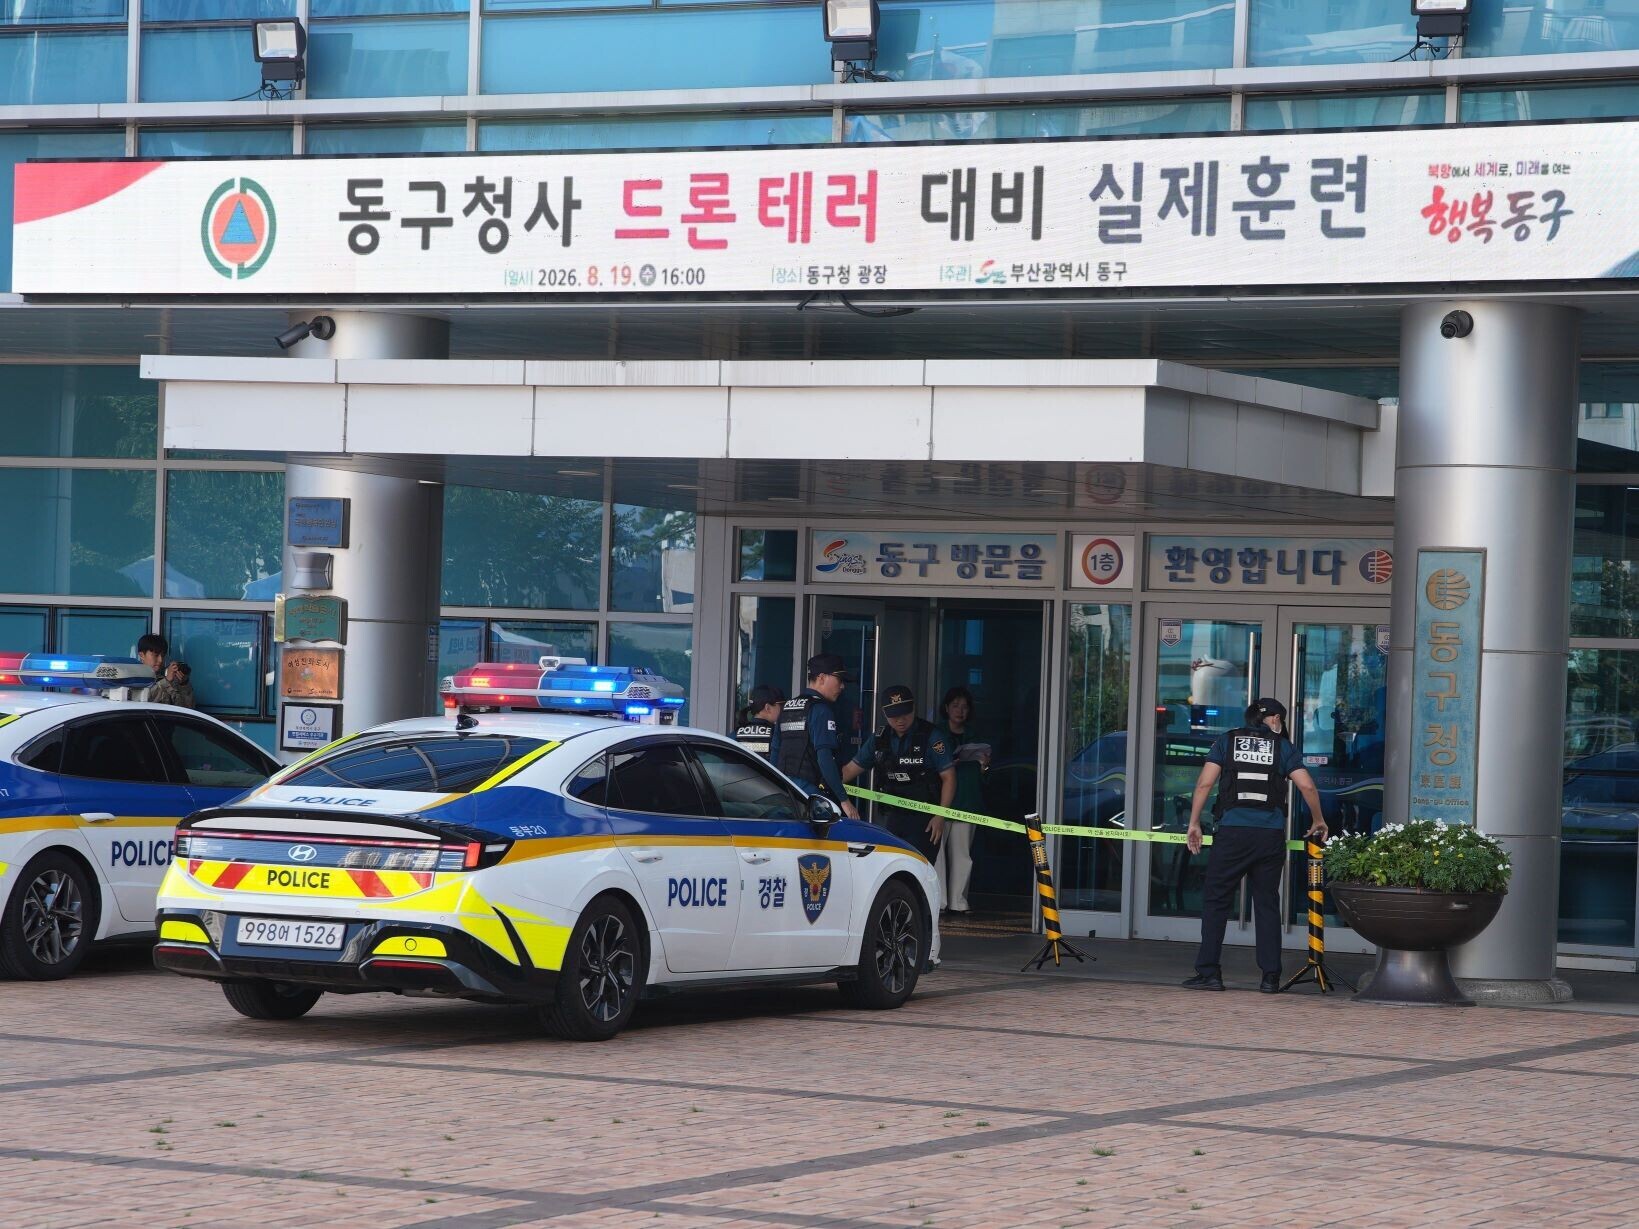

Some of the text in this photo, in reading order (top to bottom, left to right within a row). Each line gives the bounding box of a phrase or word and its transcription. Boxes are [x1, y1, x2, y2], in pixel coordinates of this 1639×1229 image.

[1474, 161, 1512, 177] 세계로,
[338, 176, 582, 256] 동구청사
[920, 166, 1044, 242] 대비
[538, 269, 582, 287] 2026.
[661, 268, 706, 286] 16:00
[806, 265, 851, 285] 동구청
[857, 264, 888, 284] 광장
[1010, 262, 1090, 283] 부산광역시
[1096, 261, 1128, 282] 동구
[875, 542, 1047, 580] 동구 방문을
[1090, 553, 1115, 572] 1층
[1164, 545, 1347, 586] 환영합니다
[784, 699, 808, 708] POLICE
[1423, 621, 1463, 767] 동구청
[737, 726, 772, 735] POLICE
[899, 757, 924, 765] POLICE
[1235, 752, 1273, 763] POLICE
[291, 795, 378, 808] POLICE
[111, 840, 177, 867] POLICE
[267, 869, 330, 890] POLICE
[667, 877, 728, 907] POLICE
[758, 876, 788, 910] 경찰
[806, 903, 822, 911] POLICE
[245, 921, 336, 945] 998어 1526
